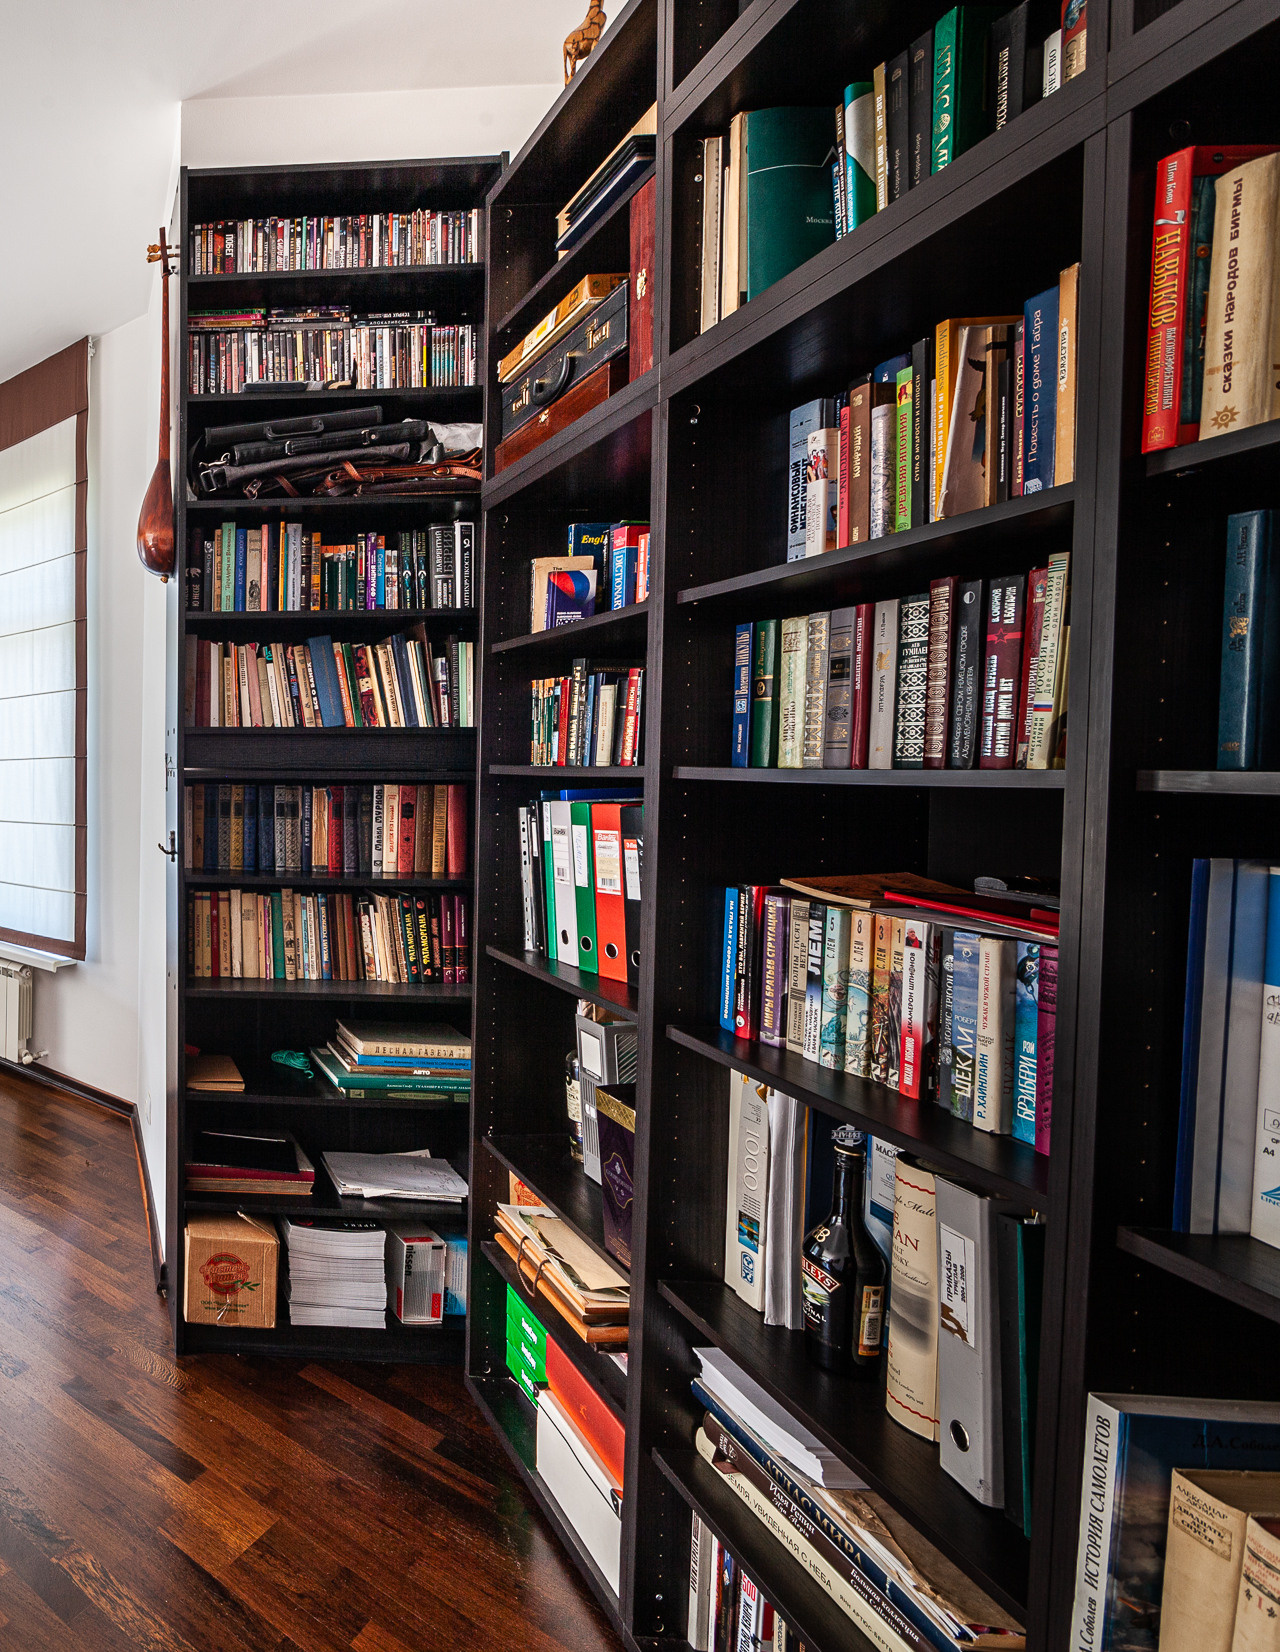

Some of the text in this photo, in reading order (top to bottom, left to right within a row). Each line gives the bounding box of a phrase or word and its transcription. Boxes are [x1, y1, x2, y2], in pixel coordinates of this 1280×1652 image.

[935, 44, 952, 114] АТЛАС
[998, 46, 1010, 91] ИСТОРИЯ
[1164, 161, 1178, 205] Шон Кови
[1228, 177, 1244, 242] БИРМЫ
[225, 233, 234, 257] ПОБЕГ
[1150, 209, 1186, 331] 7 НАВЫКОВ
[1027, 308, 1043, 463] Повесть о доме Тайра
[1145, 331, 1164, 416] ТИНЕЙДЖЕРОВ
[1161, 327, 1177, 411] ВЫСОКОЭФФЕКТИВНЫХ
[914, 374, 922, 410] ГЛУПОСТИ
[935, 327, 950, 465] Mindfulness IN PLAIN ENGLISH
[840, 413, 849, 494] SUMO WATCHING
[851, 425, 863, 478] КОНФУЦИЙ
[914, 418, 922, 454] МУДРОСТИ
[898, 412, 909, 518] ДРЕВНЯЯ ЯПОНИЯ
[789, 459, 802, 535] ФИНАНСОВЫЙ
[435, 530, 443, 573] ЛАВРЕНТИЙ
[443, 529, 453, 572] БЕРИЯ
[613, 554, 624, 611] DICTIONARY
[855, 617, 863, 651] РАСПУТИН
[1035, 575, 1055, 695] РОССИЯ и АБХАЗИЯ
[1044, 574, 1063, 694] Две страны один народ
[306, 661, 316, 688] БАНЯХ
[734, 632, 750, 695] Валентин ПИКУЛЬ
[955, 625, 967, 716] ОДНОМ НЕМЕЦКОМ ГОРОДКЕ
[1027, 656, 1039, 704] ГУДЕРИАН
[310, 688, 317, 696] О
[964, 665, 974, 740] МЕМОРАНДУМ КВИЛЛЕРА
[980, 654, 998, 757] ТРЕВОЖНЫЙ МЕСЯЦ ВЕРЕСЕНЬ
[782, 707, 790, 742] МИХАИЛ
[788, 700, 796, 743] ЗОЩЕНКО
[993, 677, 1015, 758] ОБРАТНОЙ ДОРОГИ НЕТ
[1035, 717, 1045, 748] ЗАТУЛИН
[1029, 717, 1039, 762] КОНСТАНТИН
[374, 788, 383, 851] Майкл МУРКОК
[596, 832, 618, 842] Bantex
[320, 906, 328, 939] УСПЕНСКИЙ
[729, 899, 735, 911] НА
[829, 916, 835, 931] 5
[856, 919, 863, 934] 8
[807, 918, 823, 976] ЛЕМ
[827, 937, 836, 953] ЛЕМ
[853, 940, 863, 957] ЛЕМ
[878, 925, 885, 940] 3
[896, 928, 902, 943] 1
[410, 965, 418, 975] 5
[423, 968, 432, 976] 4
[763, 899, 778, 1029] МИРЫ БРАТЬЕВ СТРУГАЦКИХ
[792, 922, 802, 988] ВОЛНЫ ГАСЯТ
[799, 942, 807, 969] ВЕТЕР
[876, 947, 886, 963] ЛЕМ
[894, 950, 904, 966] ЛЕМ
[908, 951, 916, 991] ШПИОНОВ
[723, 974, 731, 1019] МИЛЛИОНОВ
[982, 976, 990, 1001] ЧУЖОЙ
[943, 974, 954, 1047] МОРИС ДРЮОН
[954, 1014, 978, 1026] РОБЕРТ
[981, 1006, 989, 1031] ЧУЖАК
[374, 1046, 454, 1058] ЛЕСНАЯ ГАЗЕТА
[903, 1036, 915, 1087] МИХАИЛ ЛЮБИМОВ
[954, 1024, 974, 1099] ШЕКЛИ
[1022, 1040, 1035, 1055] РЭЙ
[976, 1052, 988, 1109] ХАЙНЛАЙН
[1016, 1054, 1037, 1122] БРЭДБЕРИ
[1262, 1146, 1275, 1157] A4
[903, 1200, 936, 1217] Malt
[404, 1244, 416, 1277] nissen
[945, 1249, 954, 1302] ПРИКАЗЫ
[762, 1459, 863, 1570] АТЛАС МИРА
[768, 1481, 815, 1535] Илья Репин
[1083, 1414, 1111, 1591] ИСТОРИЯ САМОЛЕТОВ
[1176, 1484, 1228, 1521] АЛЕКСАНДР
[1176, 1504, 1225, 1540] ДВАДЦАТЬ
[1185, 1497, 1215, 1519] ДЮМА
[752, 1501, 833, 1590] УВИДЕННАЯ С НЕБА
[789, 1515, 810, 1538] Repin
[1180, 1519, 1215, 1545] СПУСТЯ
[1190, 1519, 1208, 1533] ЛЕТ
[741, 1574, 757, 1603] 500
[838, 1594, 850, 1607] ЯНН
[849, 1567, 920, 1643] Большая коллекция
[740, 1597, 753, 1632] КВИРК
[867, 1602, 902, 1636] Collection
